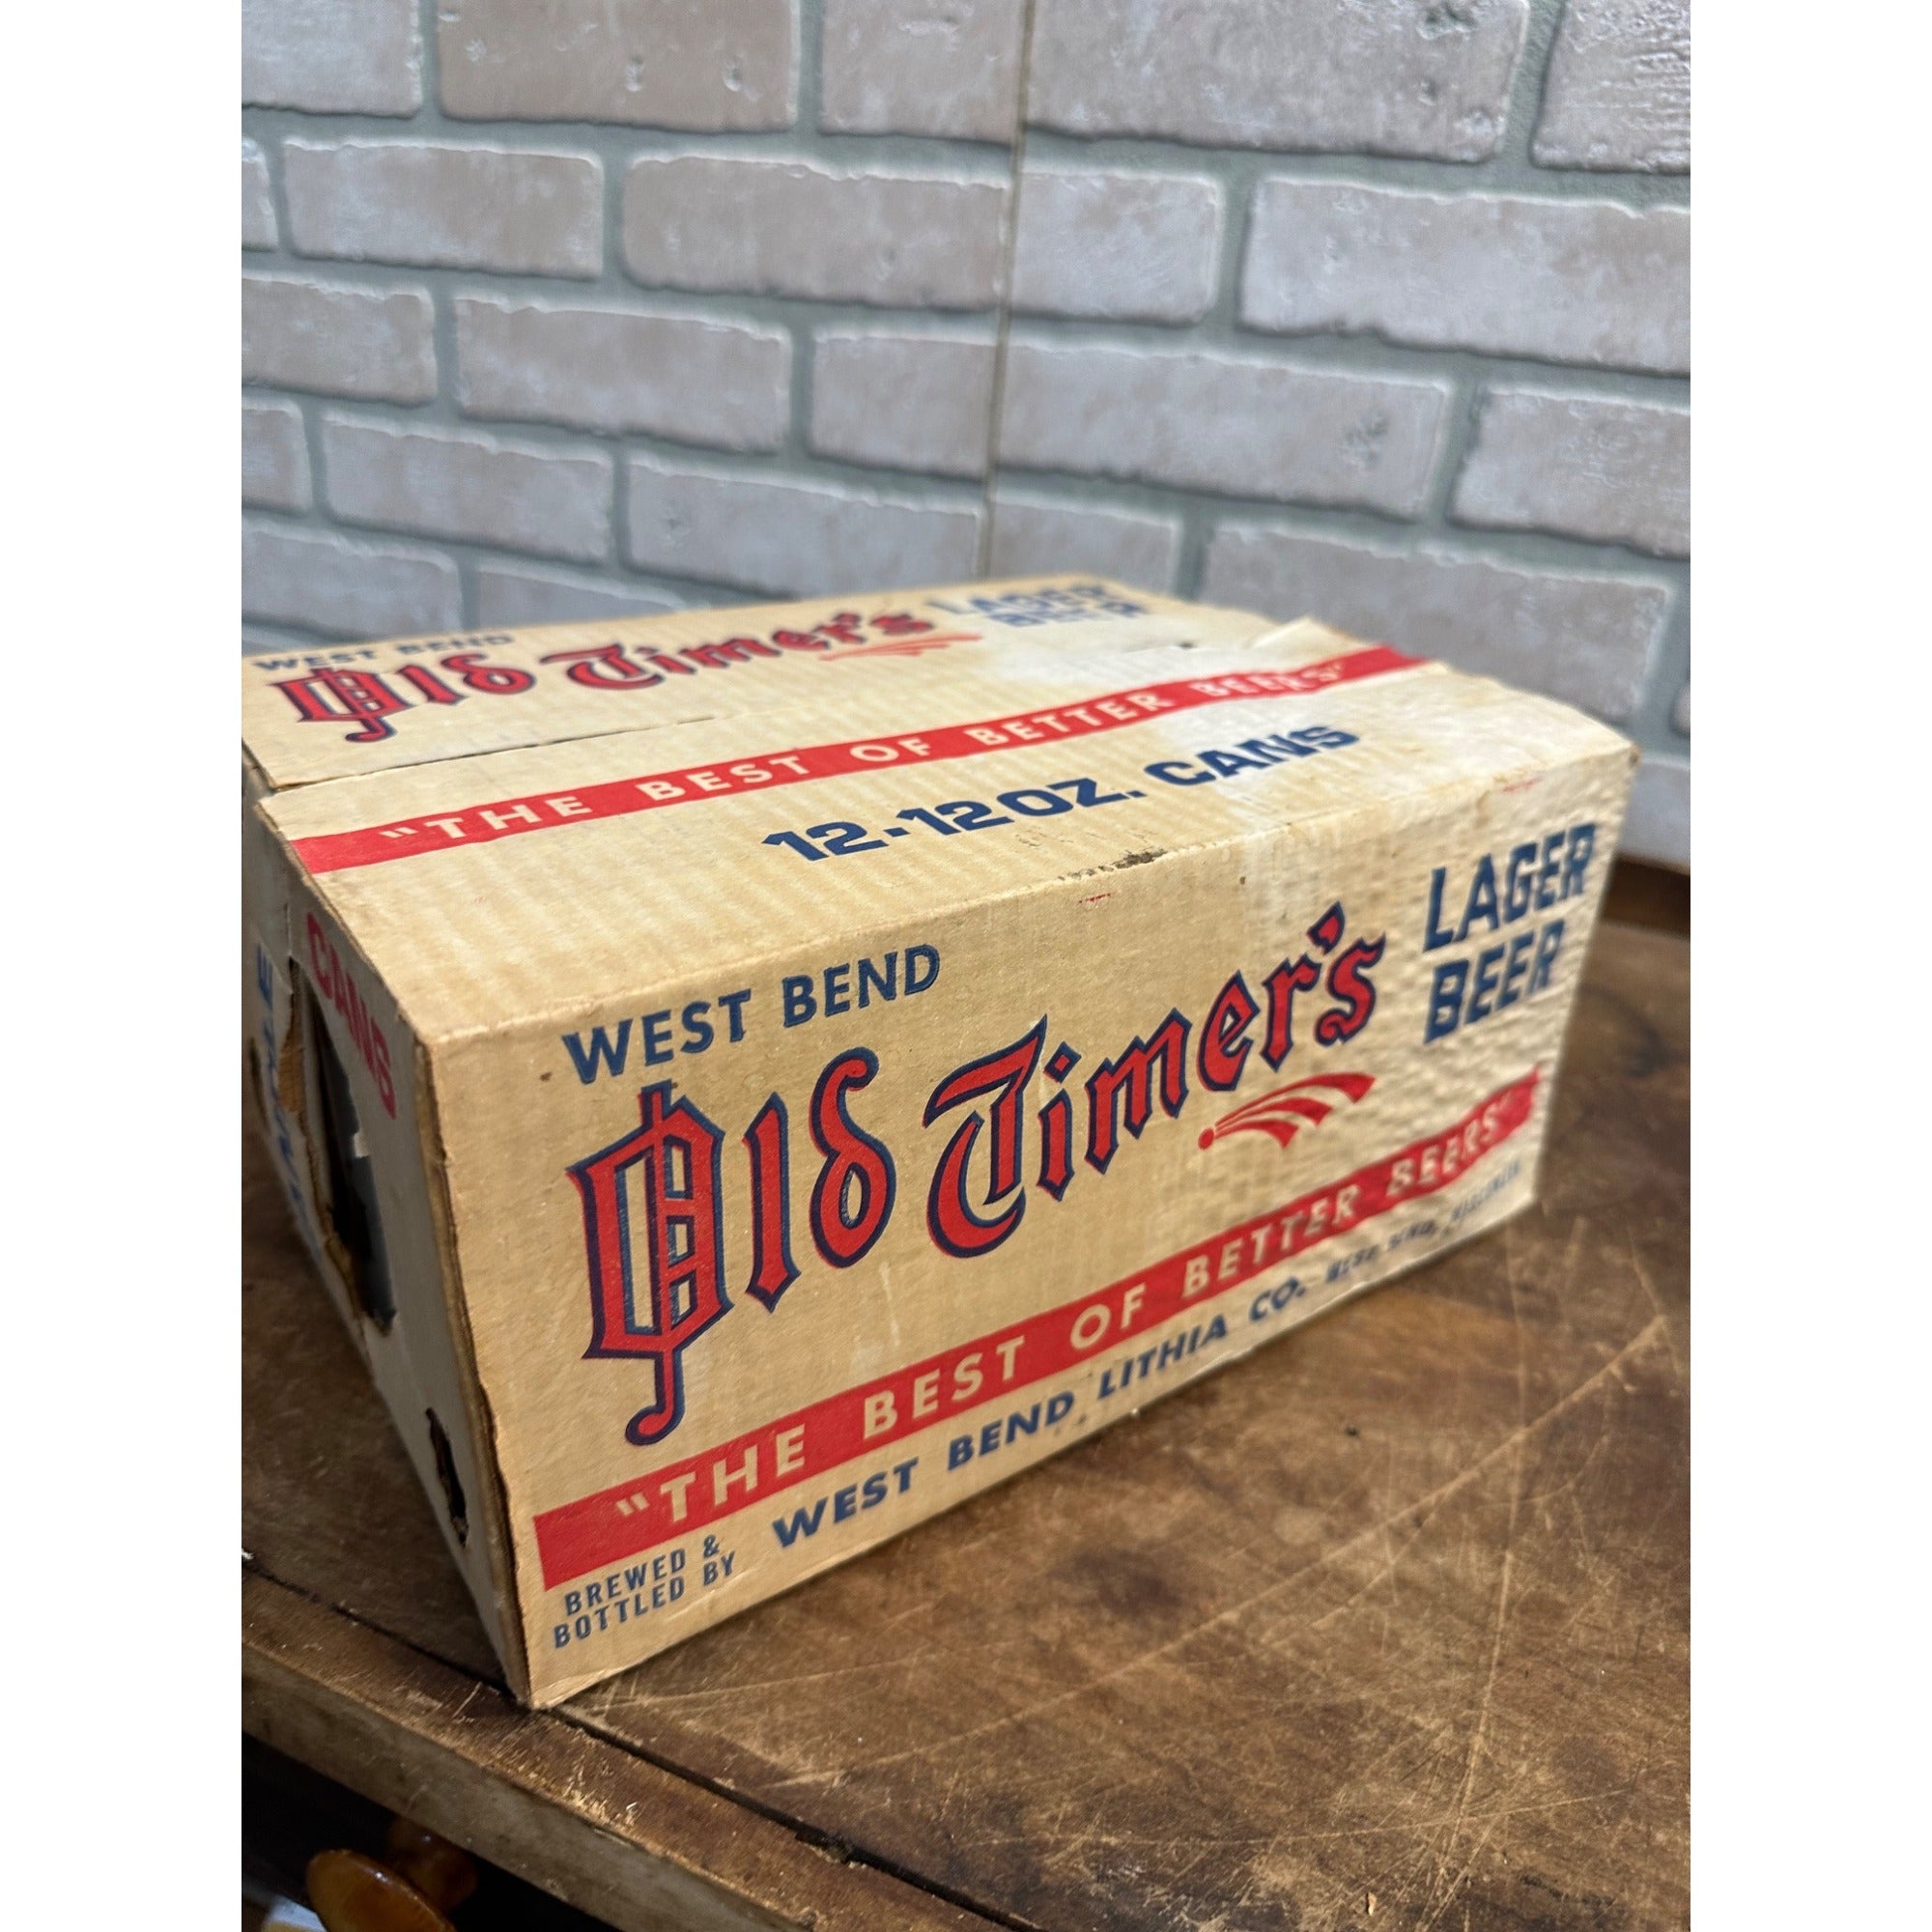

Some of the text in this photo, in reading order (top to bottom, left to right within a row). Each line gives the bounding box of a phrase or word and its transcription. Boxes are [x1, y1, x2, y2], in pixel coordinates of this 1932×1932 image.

[253, 633, 514, 670] WEST BEND
[269, 611, 935, 743] Old Timer's
[637, 753, 811, 801] BEST
[850, 737, 935, 763] OF
[964, 691, 1175, 746] BETTER
[1144, 724, 1360, 787] CANS
[1422, 822, 1596, 953] LAGER
[307, 912, 397, 1121] CANS
[561, 944, 941, 1086] WEST BEND
[1422, 919, 1567, 1044] BEER
[565, 1046, 897, 1448] Old
[921, 901, 1387, 1259] Timer's
[862, 1337, 1026, 1441] BEST
[1069, 1282, 1148, 1350] OF
[1180, 1182, 1360, 1301] BETTER
[772, 1458, 920, 1548] WEST
[947, 1390, 1076, 1472] BEND
[1096, 1314, 1228, 1401] LITHIA
[1248, 1276, 1306, 1323] CO.
[554, 1551, 736, 1649] BOTTLED BY
[563, 1534, 722, 1616] BREWED &
